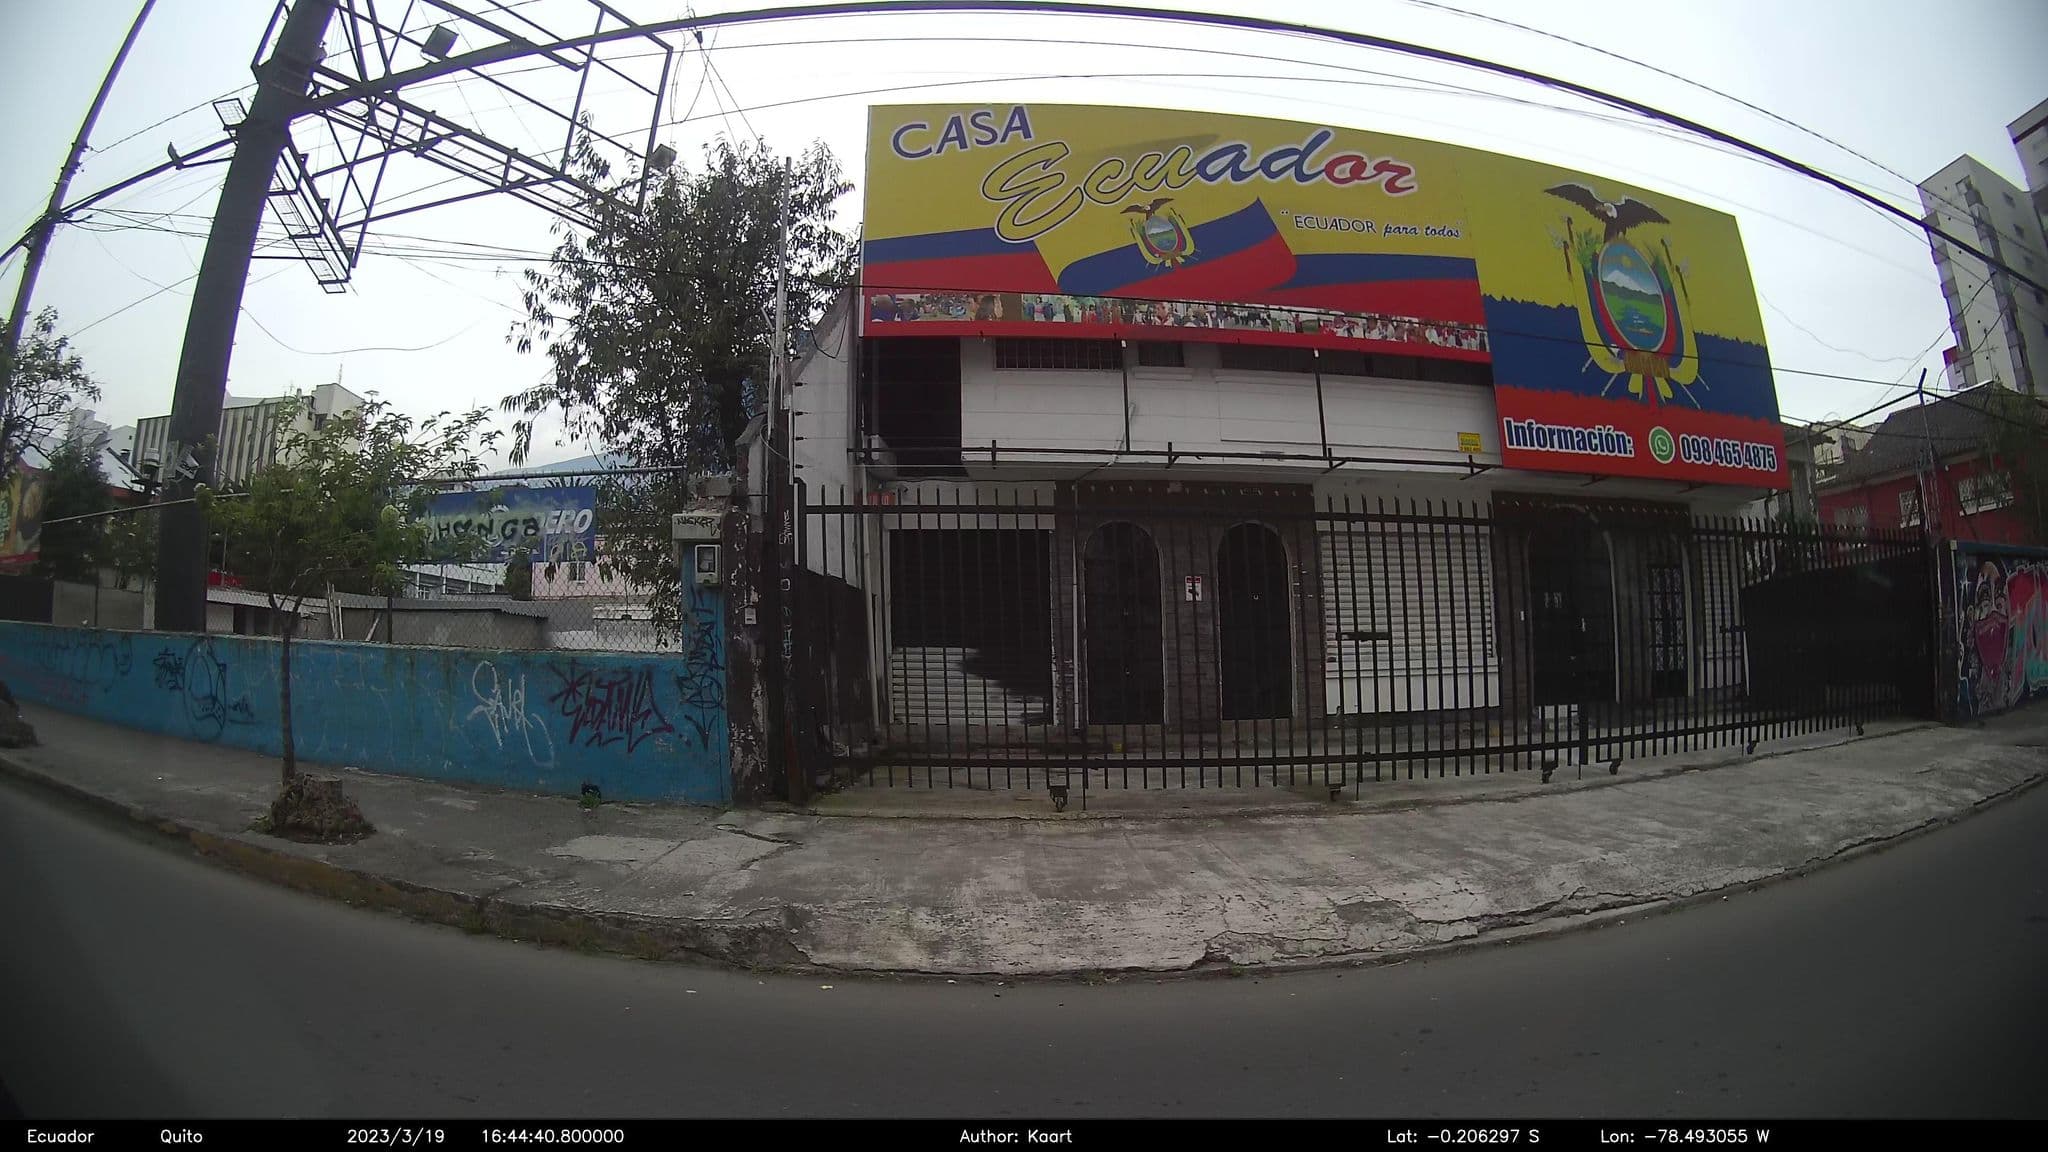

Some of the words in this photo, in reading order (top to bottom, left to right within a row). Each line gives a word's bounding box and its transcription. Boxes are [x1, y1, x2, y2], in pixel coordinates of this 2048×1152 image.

[891, 105, 1033, 159] CASA
[981, 129, 1417, 242] Ecuador
[1383, 222, 1419, 238] para
[1504, 418, 1634, 456] Información:
[1680, 434, 1713, 465] 098
[1713, 439, 1744, 468] 465
[1743, 443, 1778, 472] 4875
